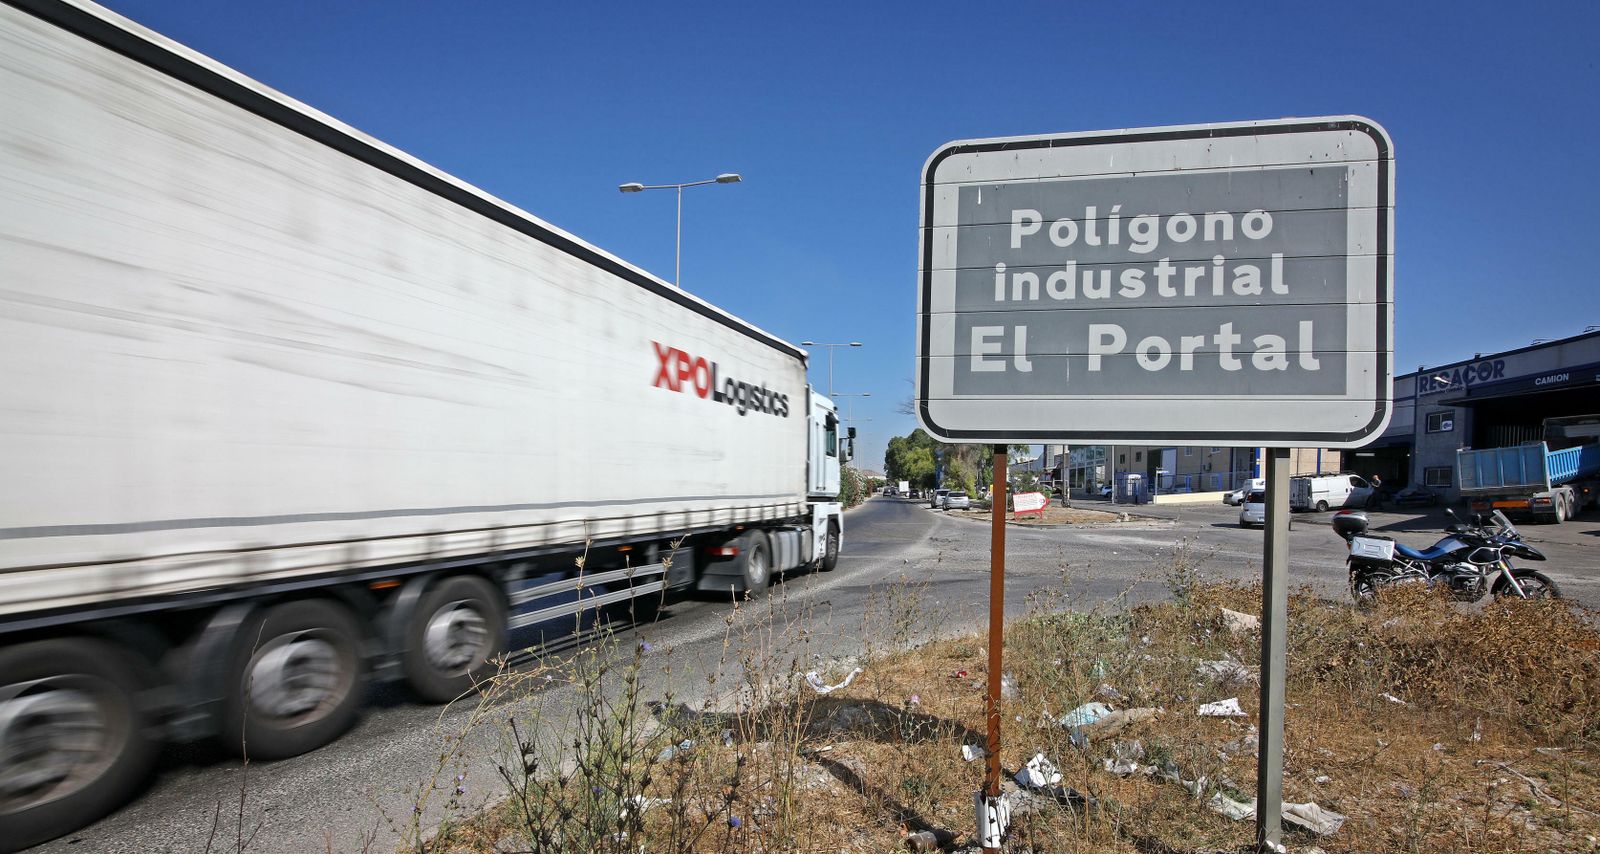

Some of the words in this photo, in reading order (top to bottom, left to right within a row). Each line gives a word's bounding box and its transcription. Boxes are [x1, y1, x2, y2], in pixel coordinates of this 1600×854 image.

[1010, 204, 1273, 253] Polígono
[995, 253, 1289, 301] industrial
[971, 325, 1033, 372] El
[1088, 320, 1320, 371] Portal
[650, 340, 711, 399] XPO
[711, 361, 789, 417] Logistics
